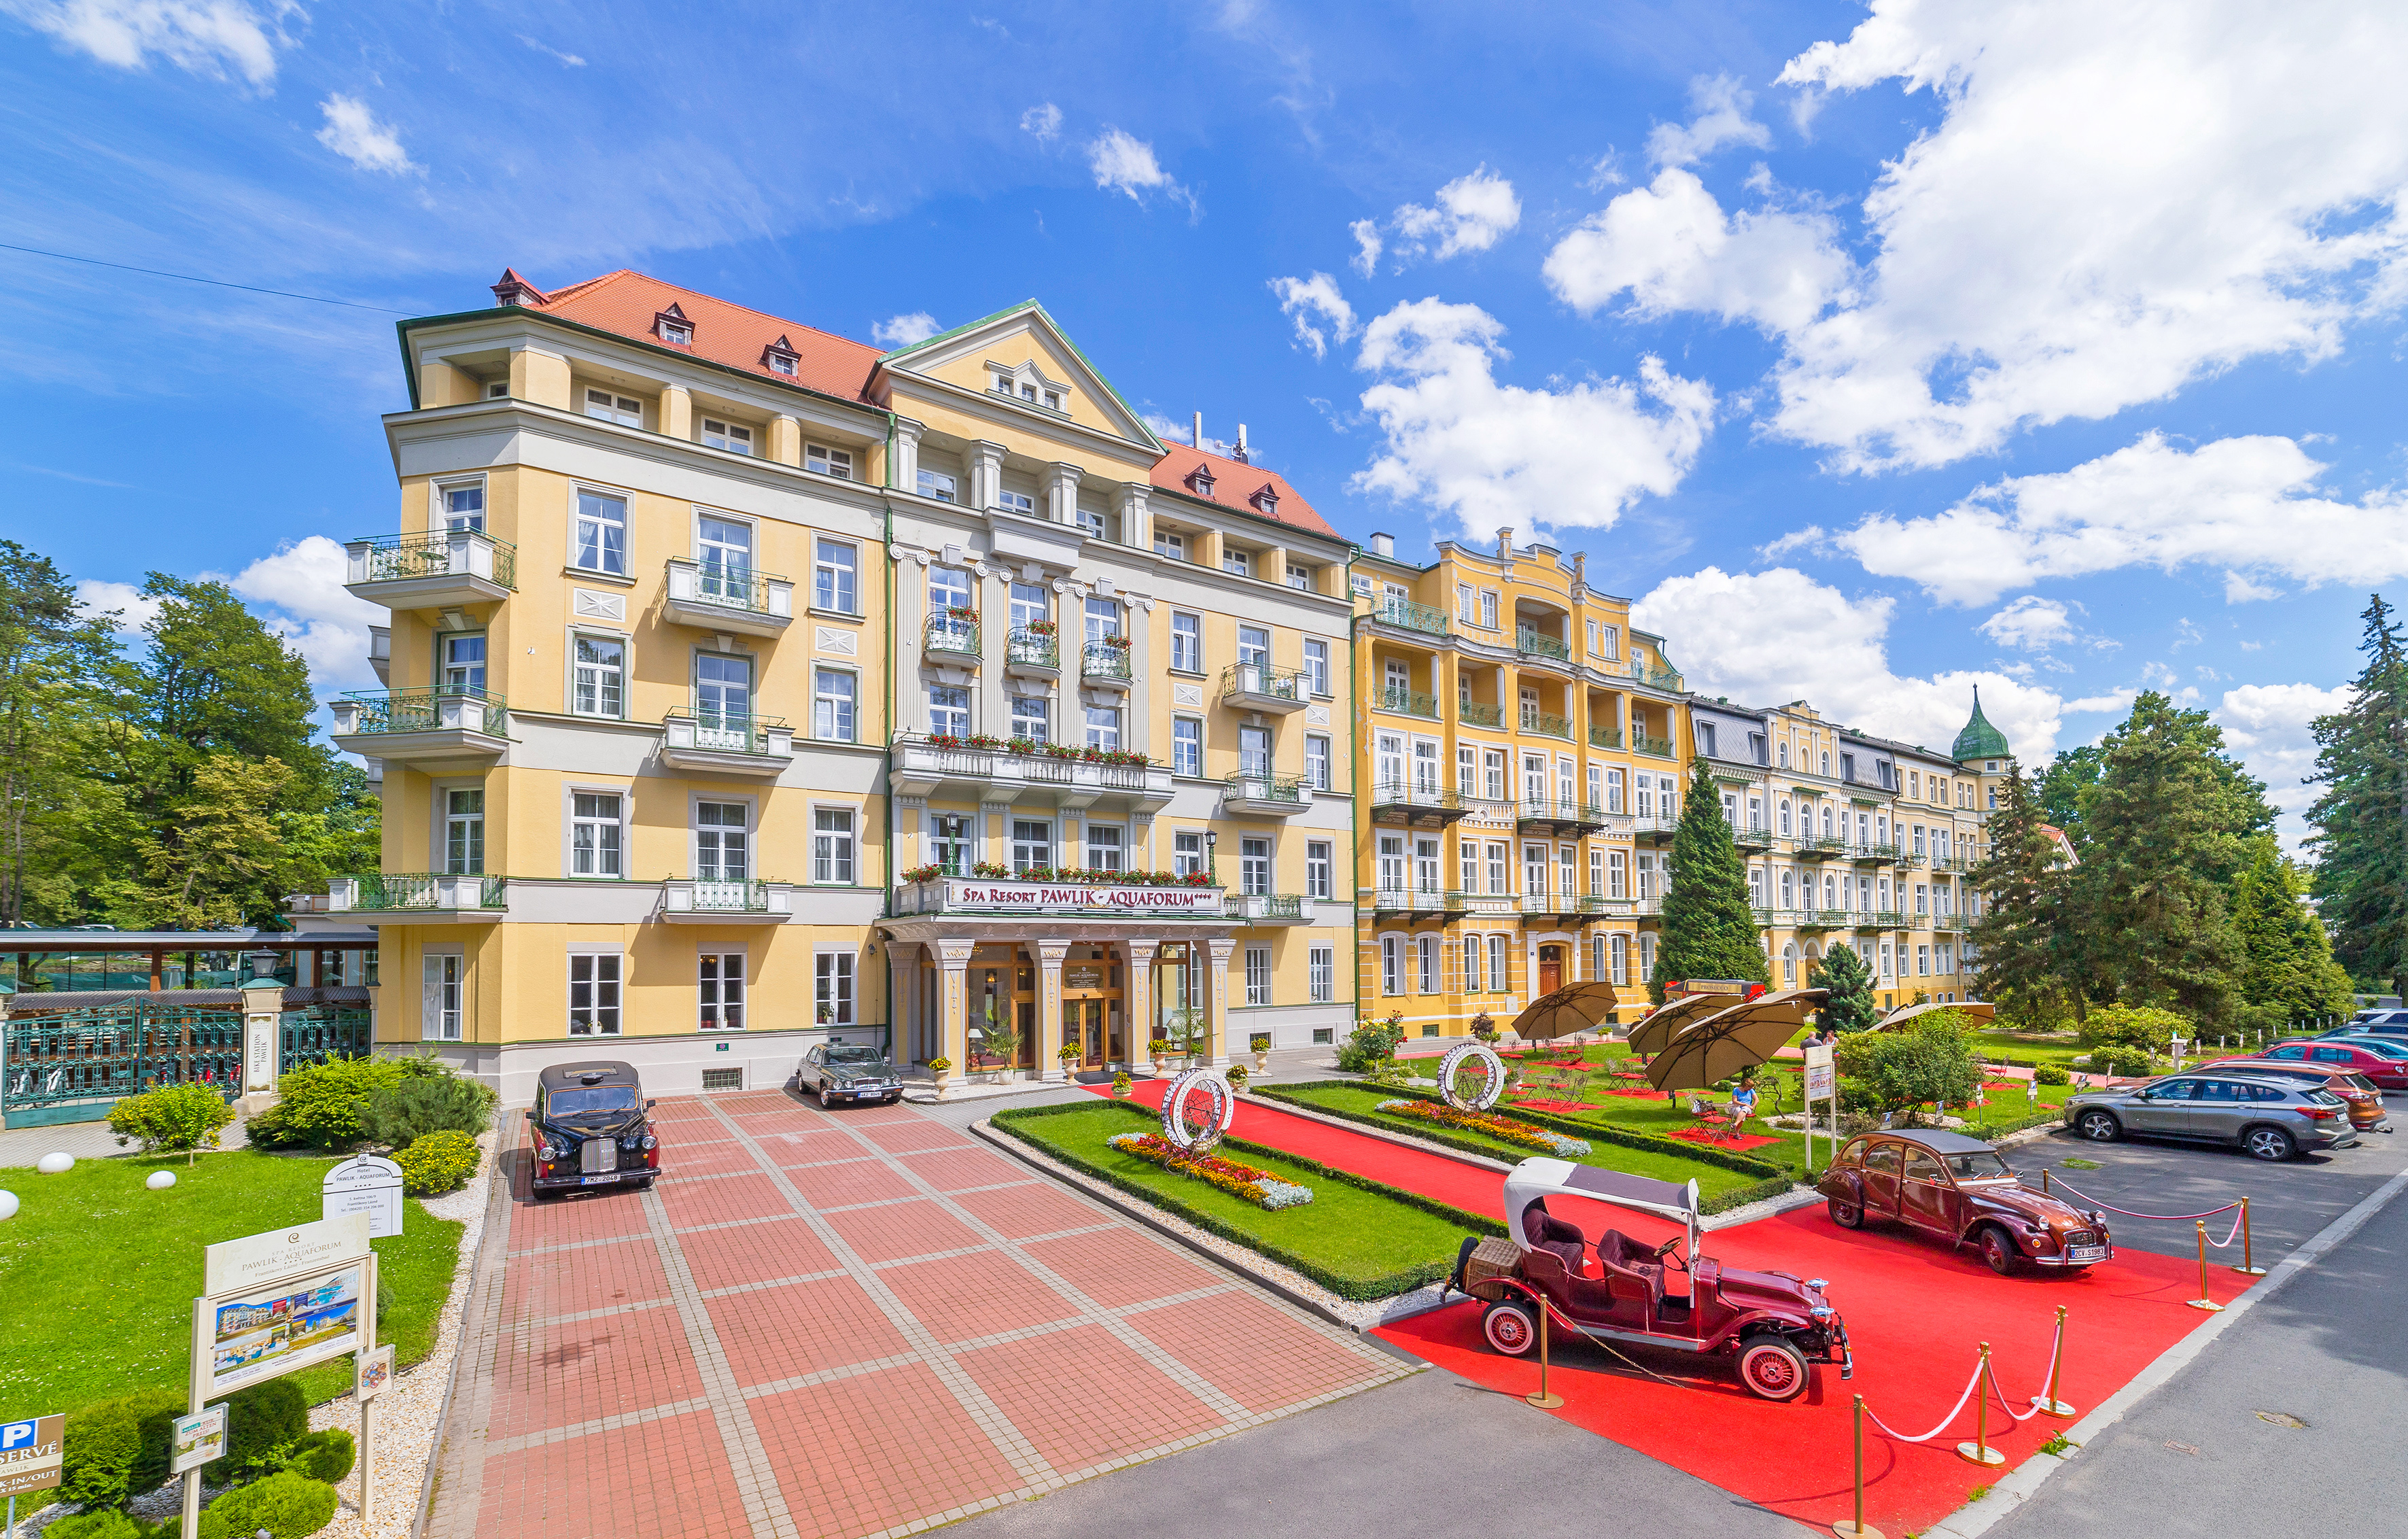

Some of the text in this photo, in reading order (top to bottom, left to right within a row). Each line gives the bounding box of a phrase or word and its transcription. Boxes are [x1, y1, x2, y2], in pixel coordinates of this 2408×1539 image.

[1040, 889, 1096, 904] PAWLIK
[1456, 1048, 1475, 1061] RESORT
[1476, 1048, 1495, 1059] PAWLIK
[1176, 1086, 1189, 1113] RESORT
[1188, 1072, 1208, 1086] PAWLIK
[1212, 1073, 1232, 1107] AQUAFORUM
[288, 1242, 315, 1252] RESORT
[241, 1256, 278, 1271] PAWLIK
[284, 1241, 341, 1261] AQUAFORUM
[255, 1266, 283, 1277] Františkovy
[301, 1255, 330, 1266] Franzensbad
[264, 1292, 283, 1301] PAWLIK
[199, 1422, 217, 1431] ALTEN
[2, 1423, 32, 1449] P
